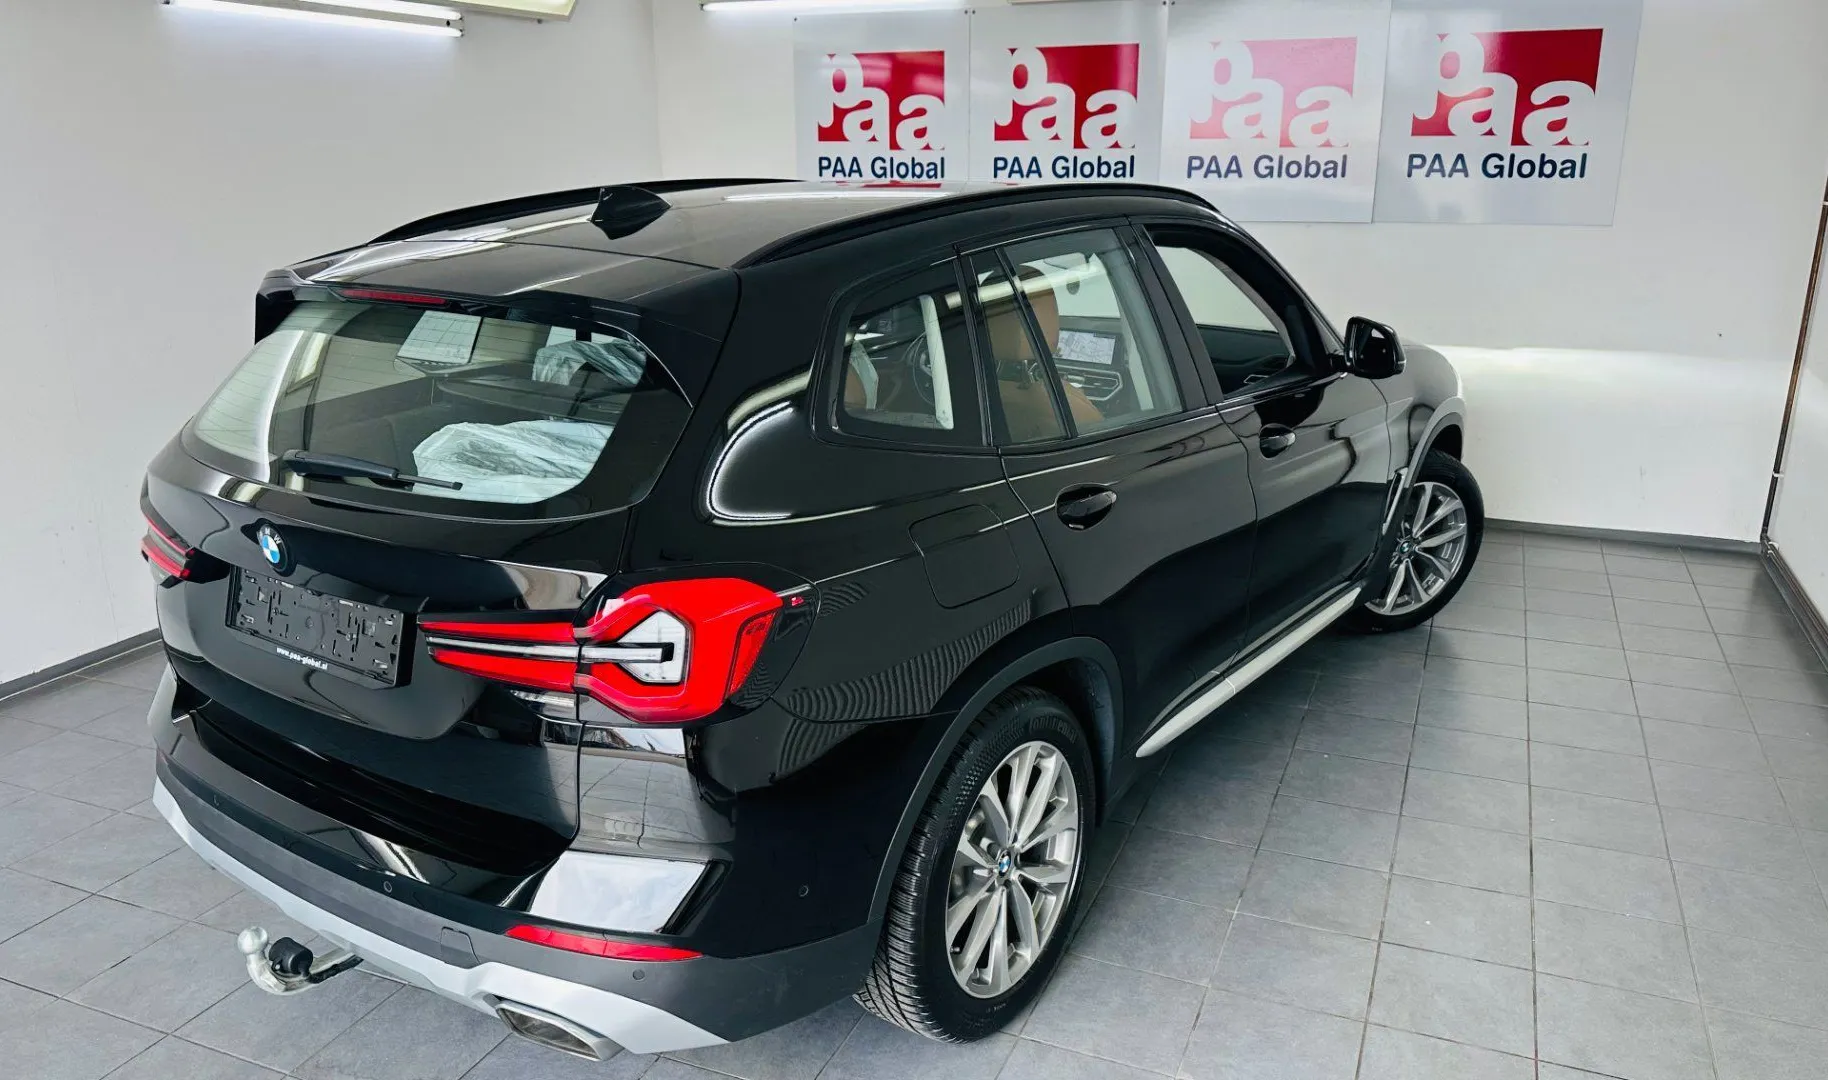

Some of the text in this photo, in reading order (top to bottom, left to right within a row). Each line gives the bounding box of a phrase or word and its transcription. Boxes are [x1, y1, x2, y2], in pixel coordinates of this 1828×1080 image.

[818, 156, 945, 179] PAA Global
[994, 155, 1135, 179] PAA Global
[1187, 154, 1347, 179] PAA Global
[1407, 153, 1587, 178] PAA Global
